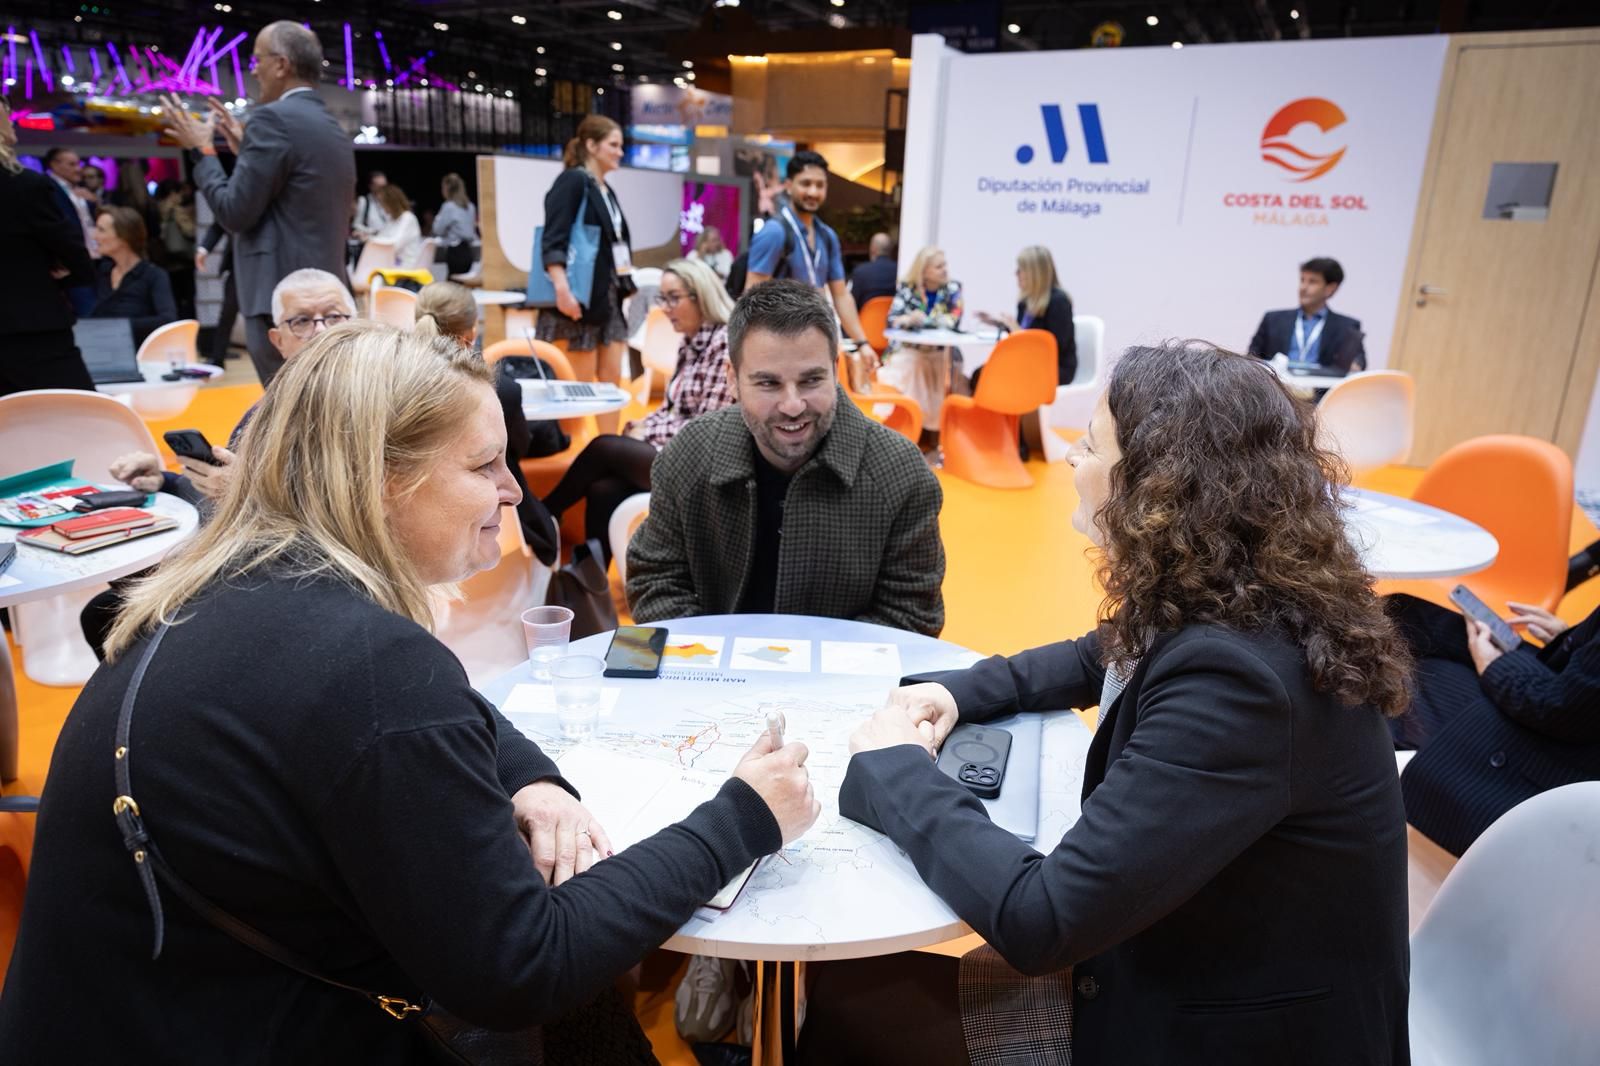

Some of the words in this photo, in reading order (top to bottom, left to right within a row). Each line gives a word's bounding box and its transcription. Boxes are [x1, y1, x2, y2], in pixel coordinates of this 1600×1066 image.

[977, 176, 1062, 196] Diputación
[1067, 177, 1150, 195] Provincial
[1017, 199, 1036, 213] de
[1040, 197, 1101, 216] Málaga
[1223, 192, 1283, 209] COSTA
[1288, 194, 1324, 210] DEL
[1330, 196, 1368, 211] SOL
